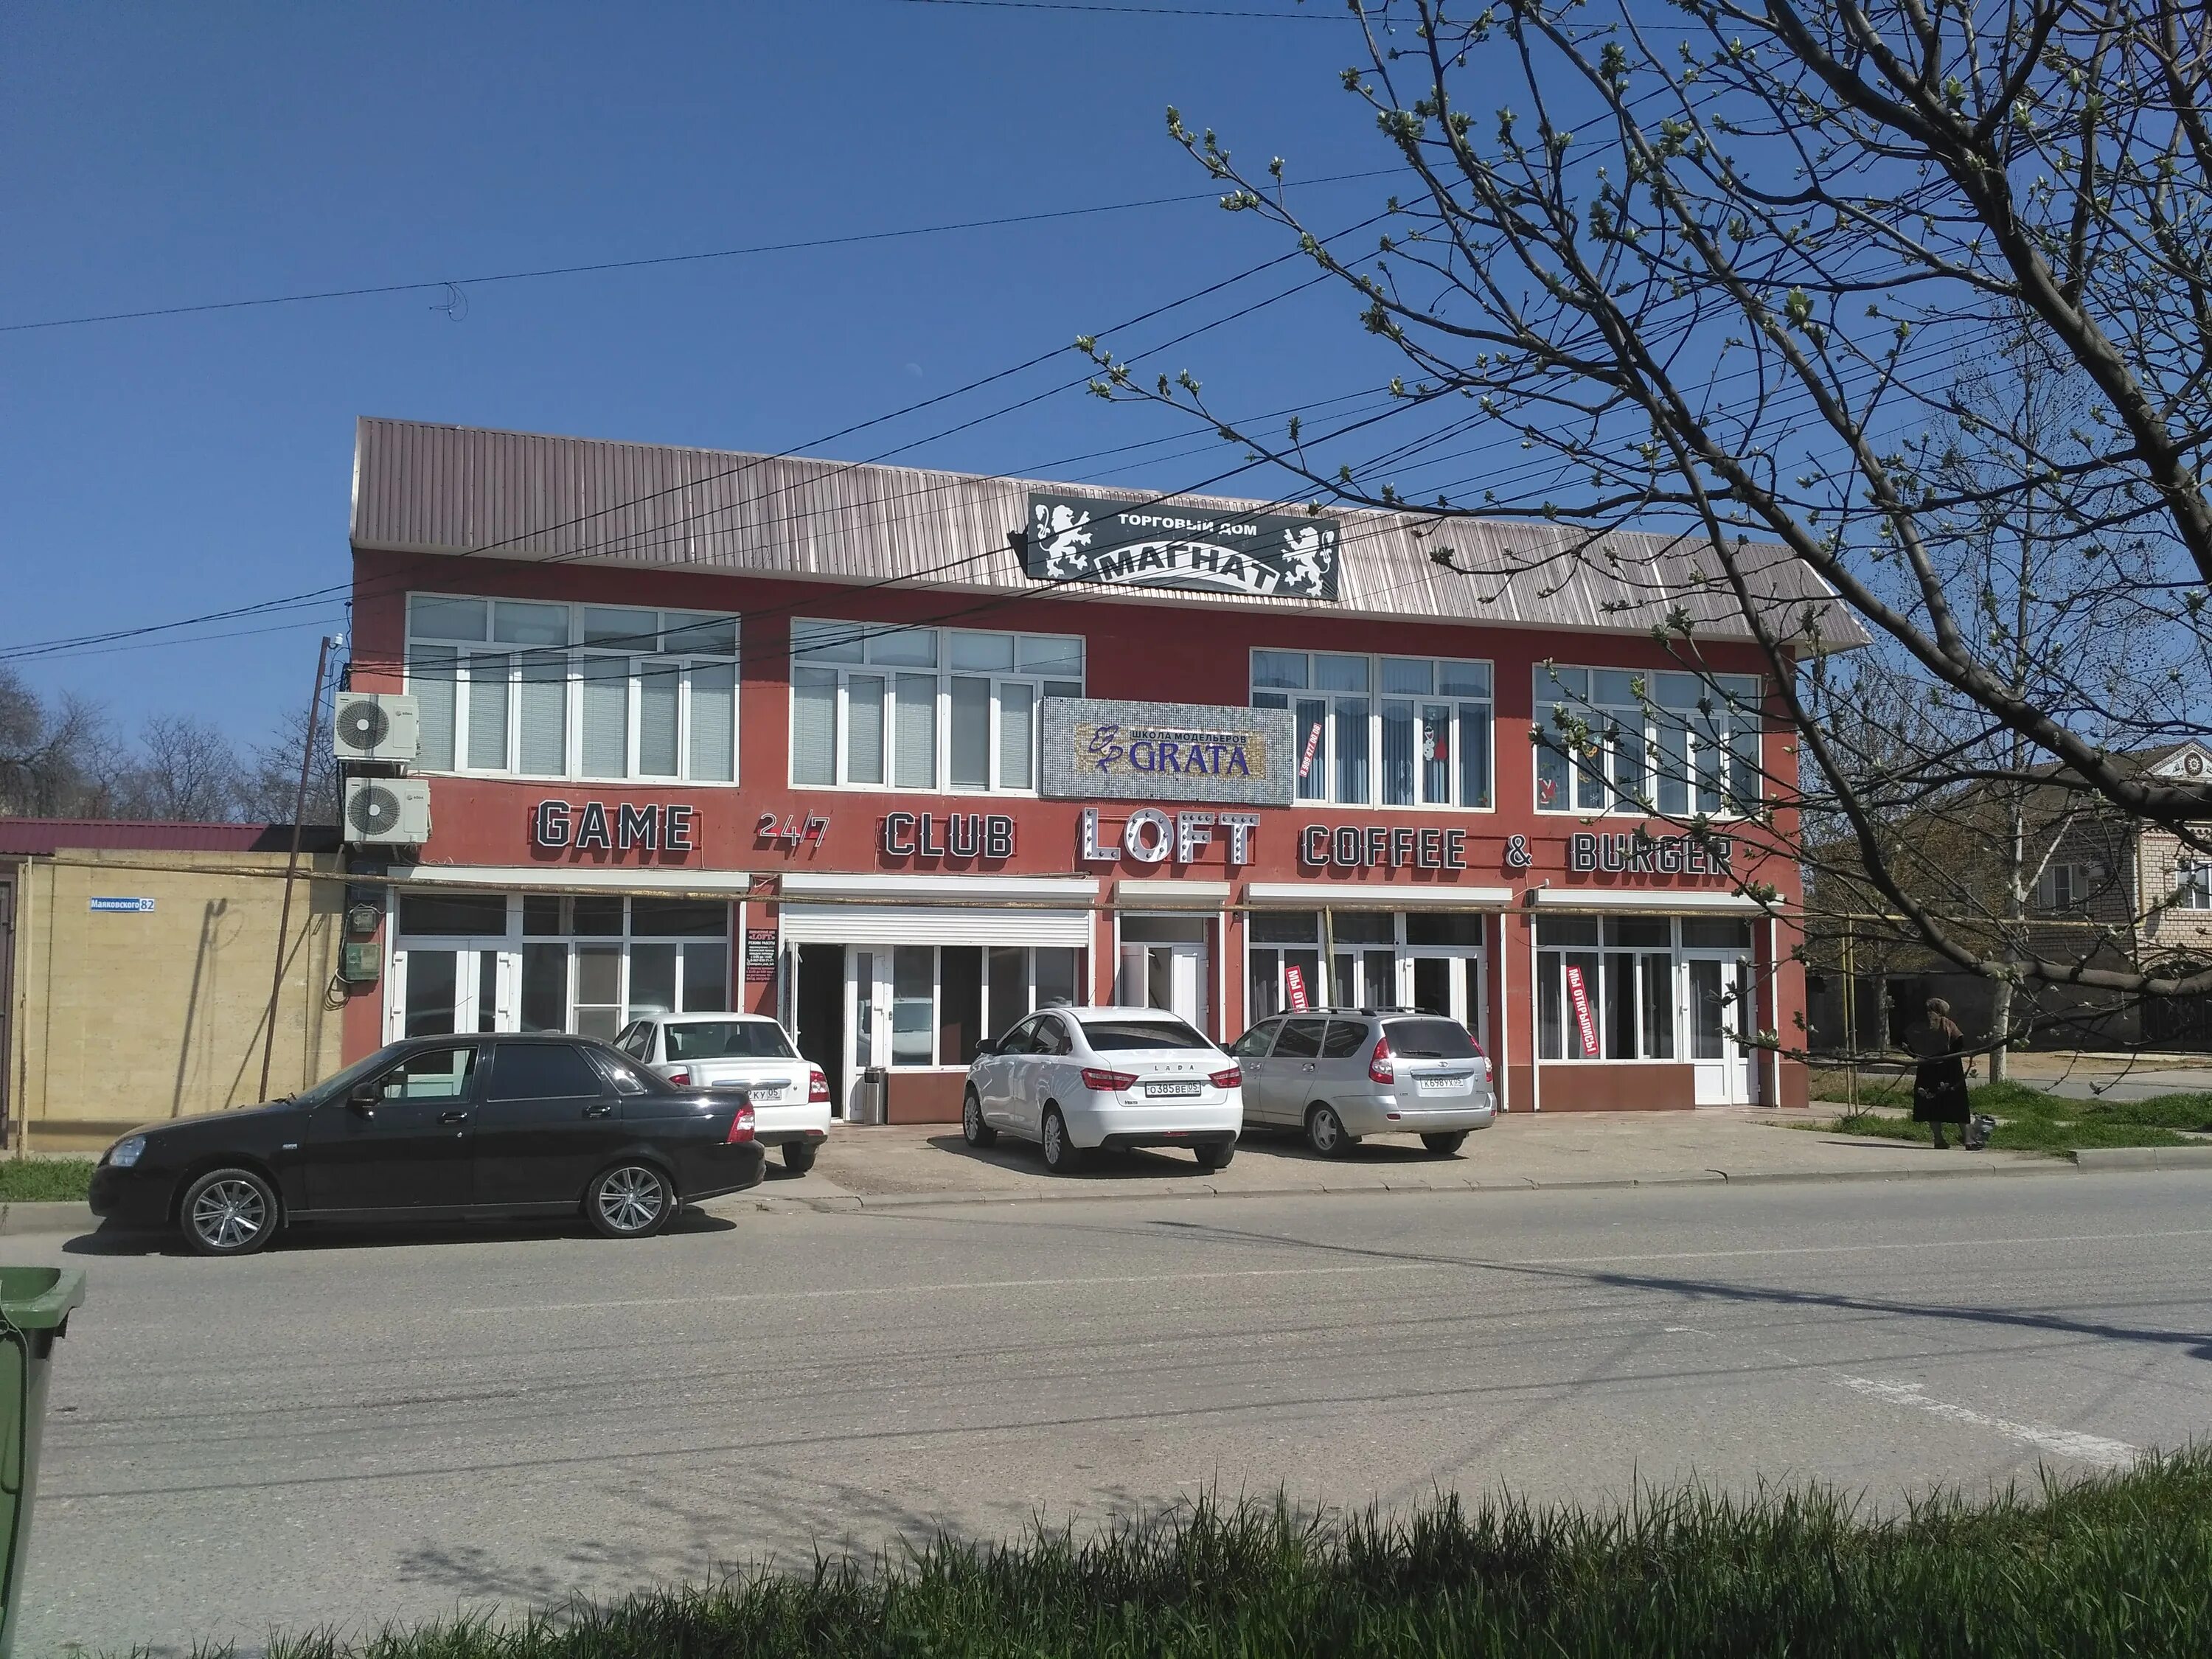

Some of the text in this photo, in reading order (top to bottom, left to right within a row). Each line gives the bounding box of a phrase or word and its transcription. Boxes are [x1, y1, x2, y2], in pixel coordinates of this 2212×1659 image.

[1118, 513, 1257, 536] ТОРГОВЫЙ ДОМ
[1099, 546, 1276, 589] МАГНАТ
[1132, 730, 1248, 744] ШКОЛА МОДЕЛЬЕРОВ
[1310, 734, 1318, 744] 00
[1306, 742, 1315, 757] 477
[1129, 741, 1251, 776] GRATA
[1301, 757, 1311, 771] 989
[537, 799, 1733, 875] GAME 24/7 CLUB LOFT COFFEE & BURGER
[91, 899, 154, 910] Маяковского 82
[1287, 970, 1302, 990] МЫ
[1568, 968, 1582, 988] МЫ
[768, 1088, 779, 1096] 05
